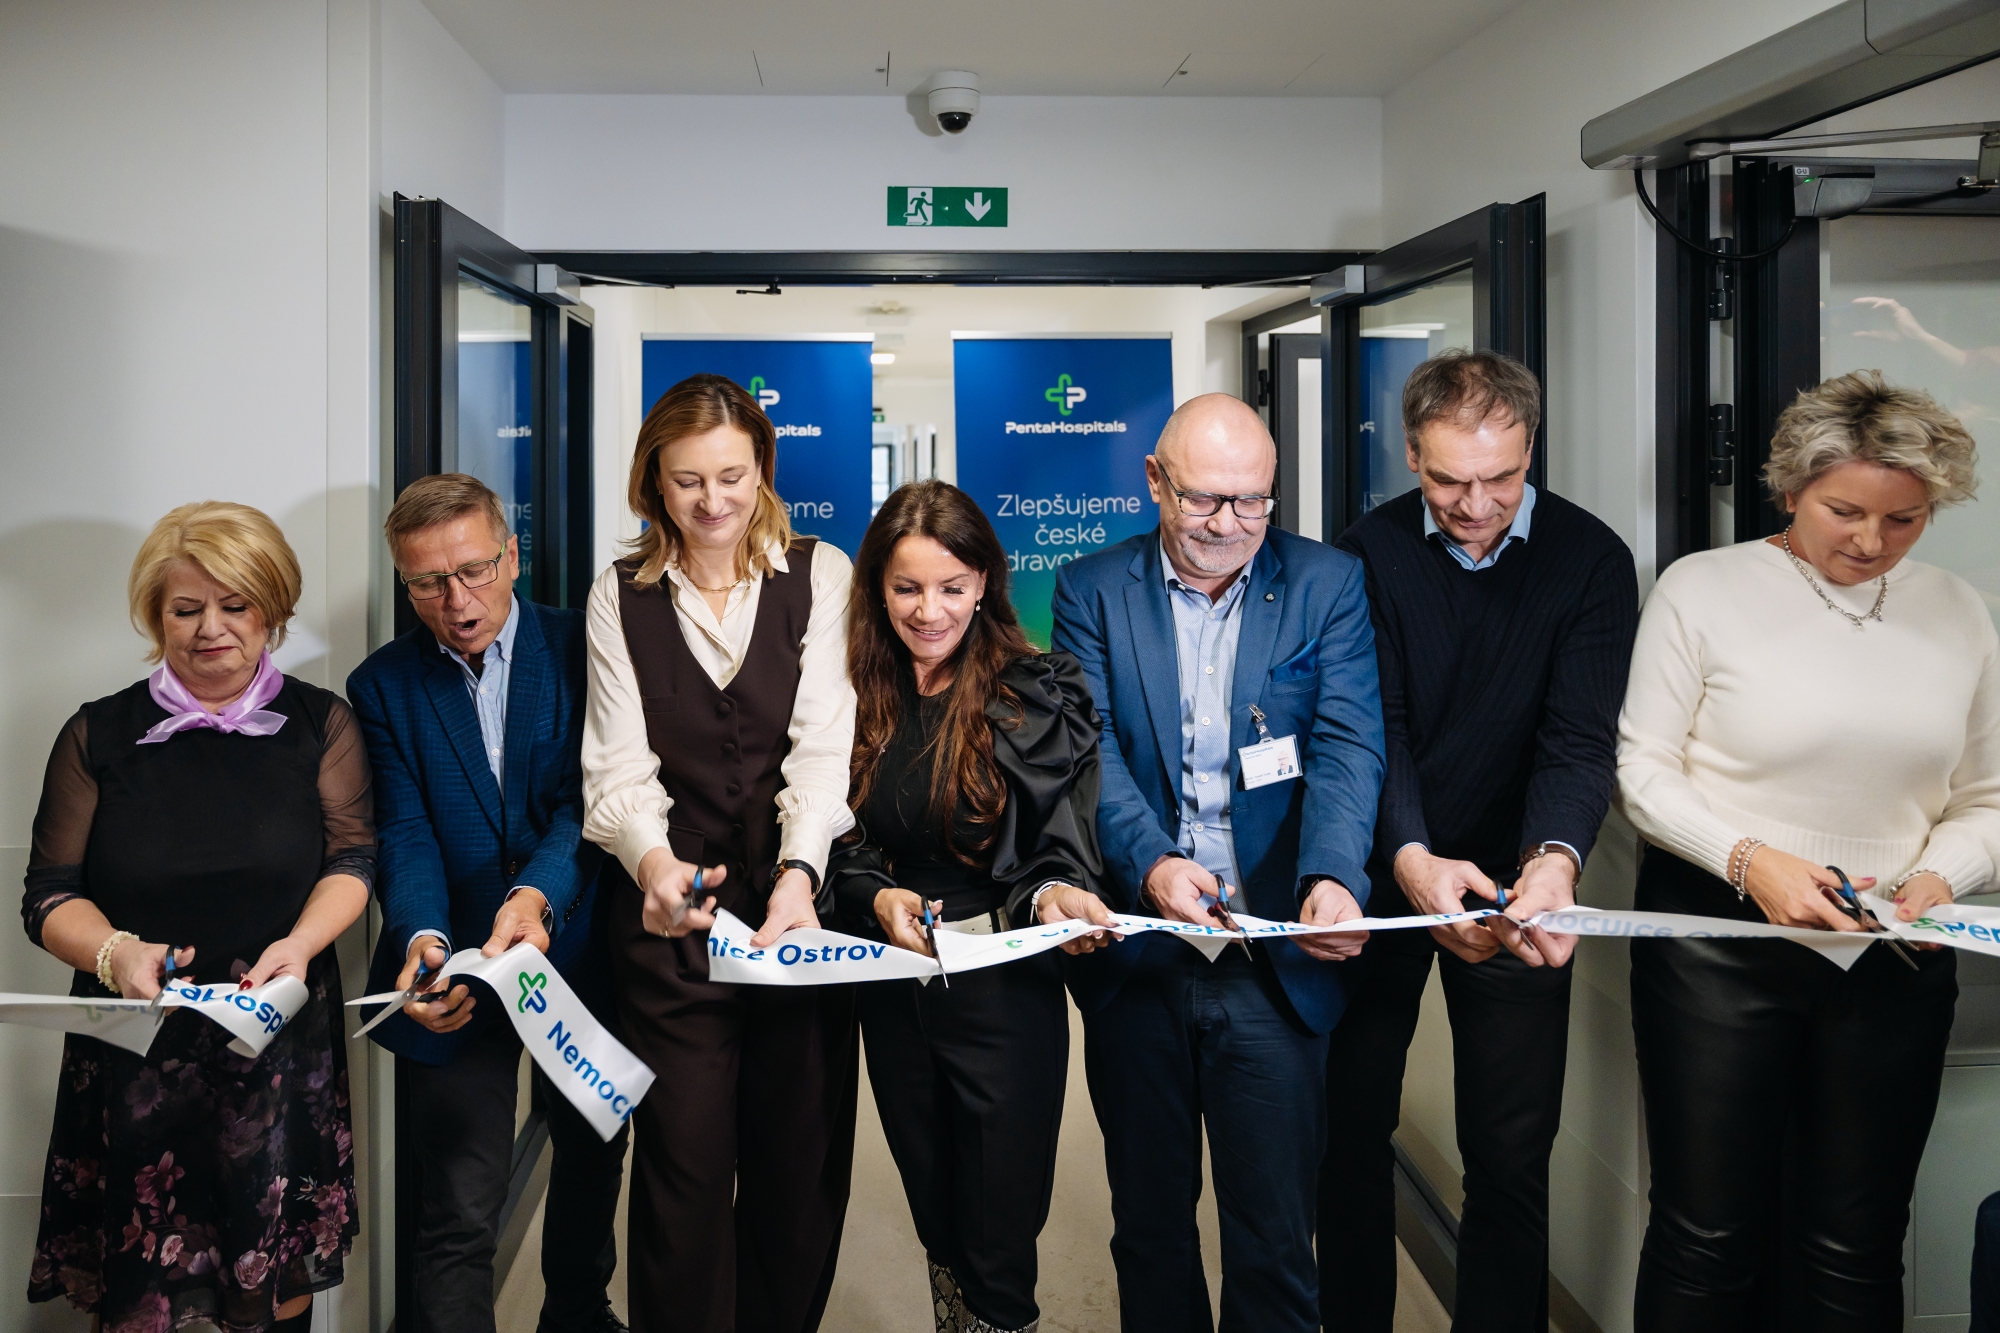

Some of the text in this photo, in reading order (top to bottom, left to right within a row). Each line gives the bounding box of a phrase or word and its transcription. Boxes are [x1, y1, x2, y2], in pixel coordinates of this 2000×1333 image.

[1005, 420, 1127, 435] PentaHospitals
[996, 492, 1141, 519] Zlepšujeme
[1034, 522, 1106, 546] české
[777, 944, 886, 966] Ostrov
